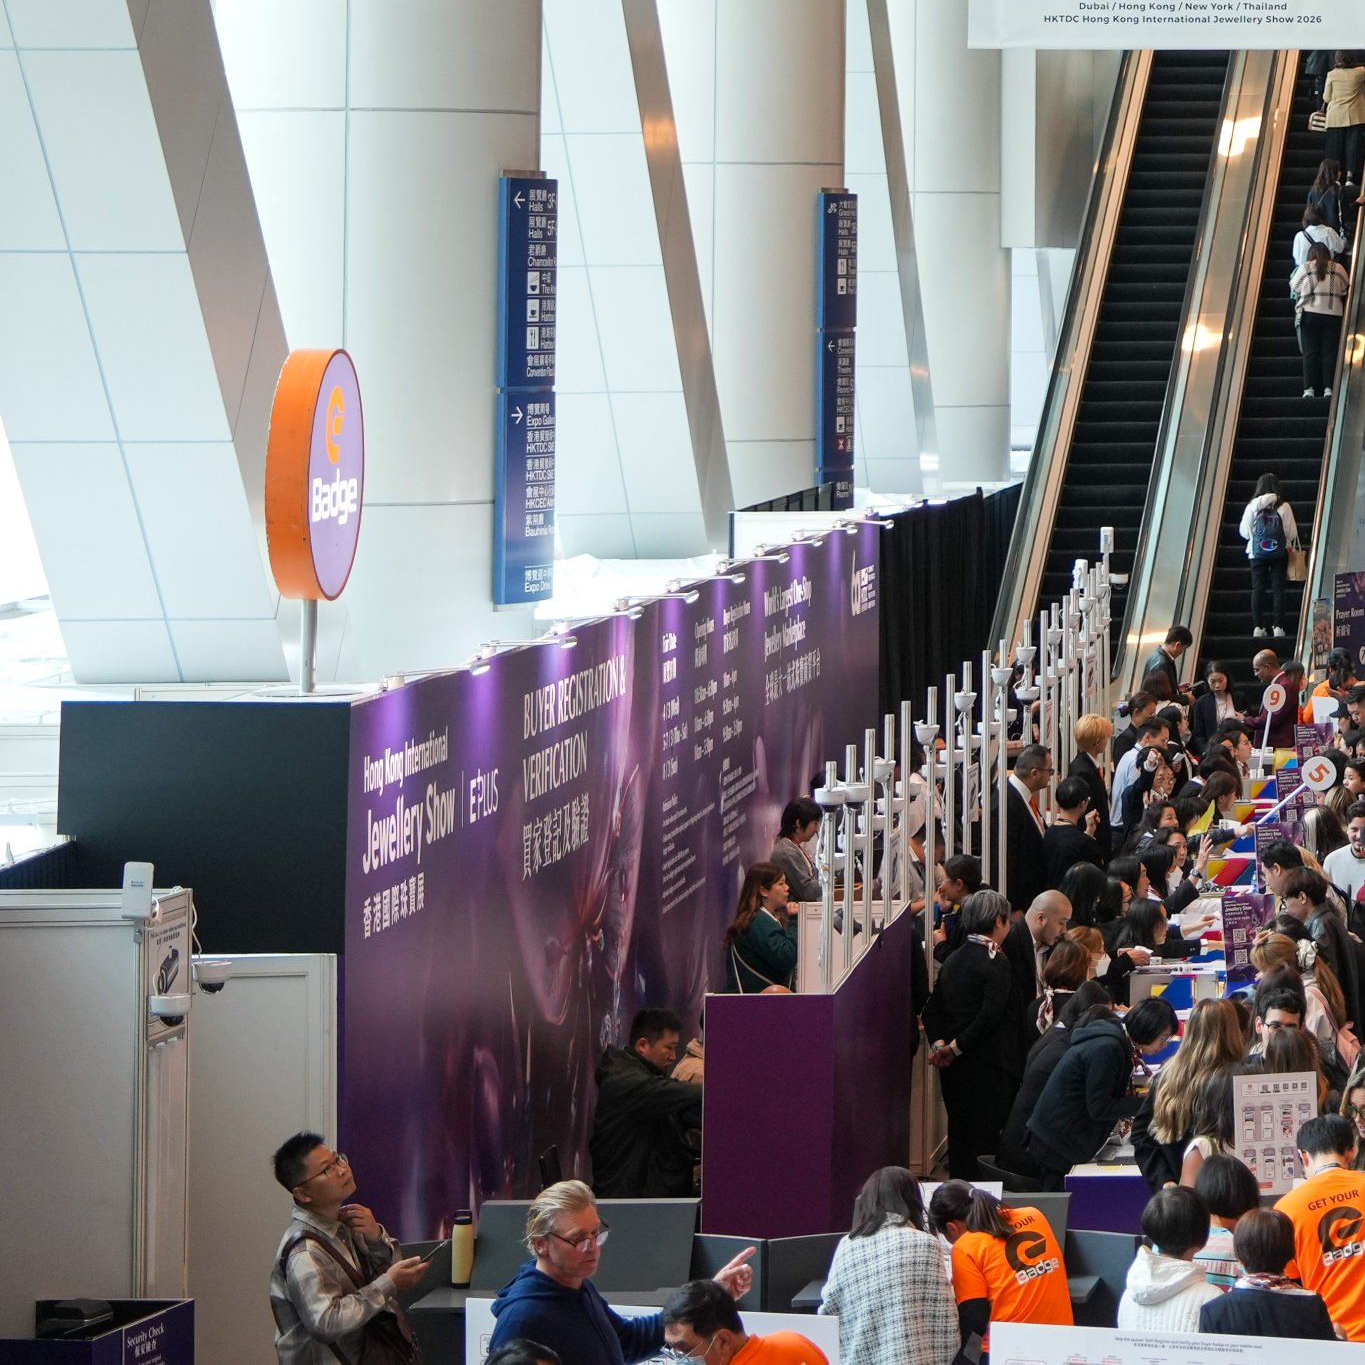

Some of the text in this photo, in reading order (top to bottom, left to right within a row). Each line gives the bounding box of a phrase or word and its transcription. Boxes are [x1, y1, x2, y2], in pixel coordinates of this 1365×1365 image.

[528, 201, 543, 213] Halls
[528, 227, 543, 239] Halls
[526, 415, 542, 428] Expo
[526, 442, 547, 453] HKTDC
[312, 468, 358, 525] Badge
[523, 654, 626, 740] BUYER REGISTRATION &
[364, 724, 448, 796] Hong Kong International
[522, 731, 588, 804] VERIFICATION
[362, 793, 424, 875] Jewellery
[426, 780, 456, 845] Show
[522, 792, 590, 882] 買家登記及驗證
[363, 871, 425, 940] 香港國際珠寶展
[1307, 1189, 1360, 1211] GET YOUR
[1015, 1257, 1060, 1285] Badge
[127, 1322, 165, 1348] Security Check
